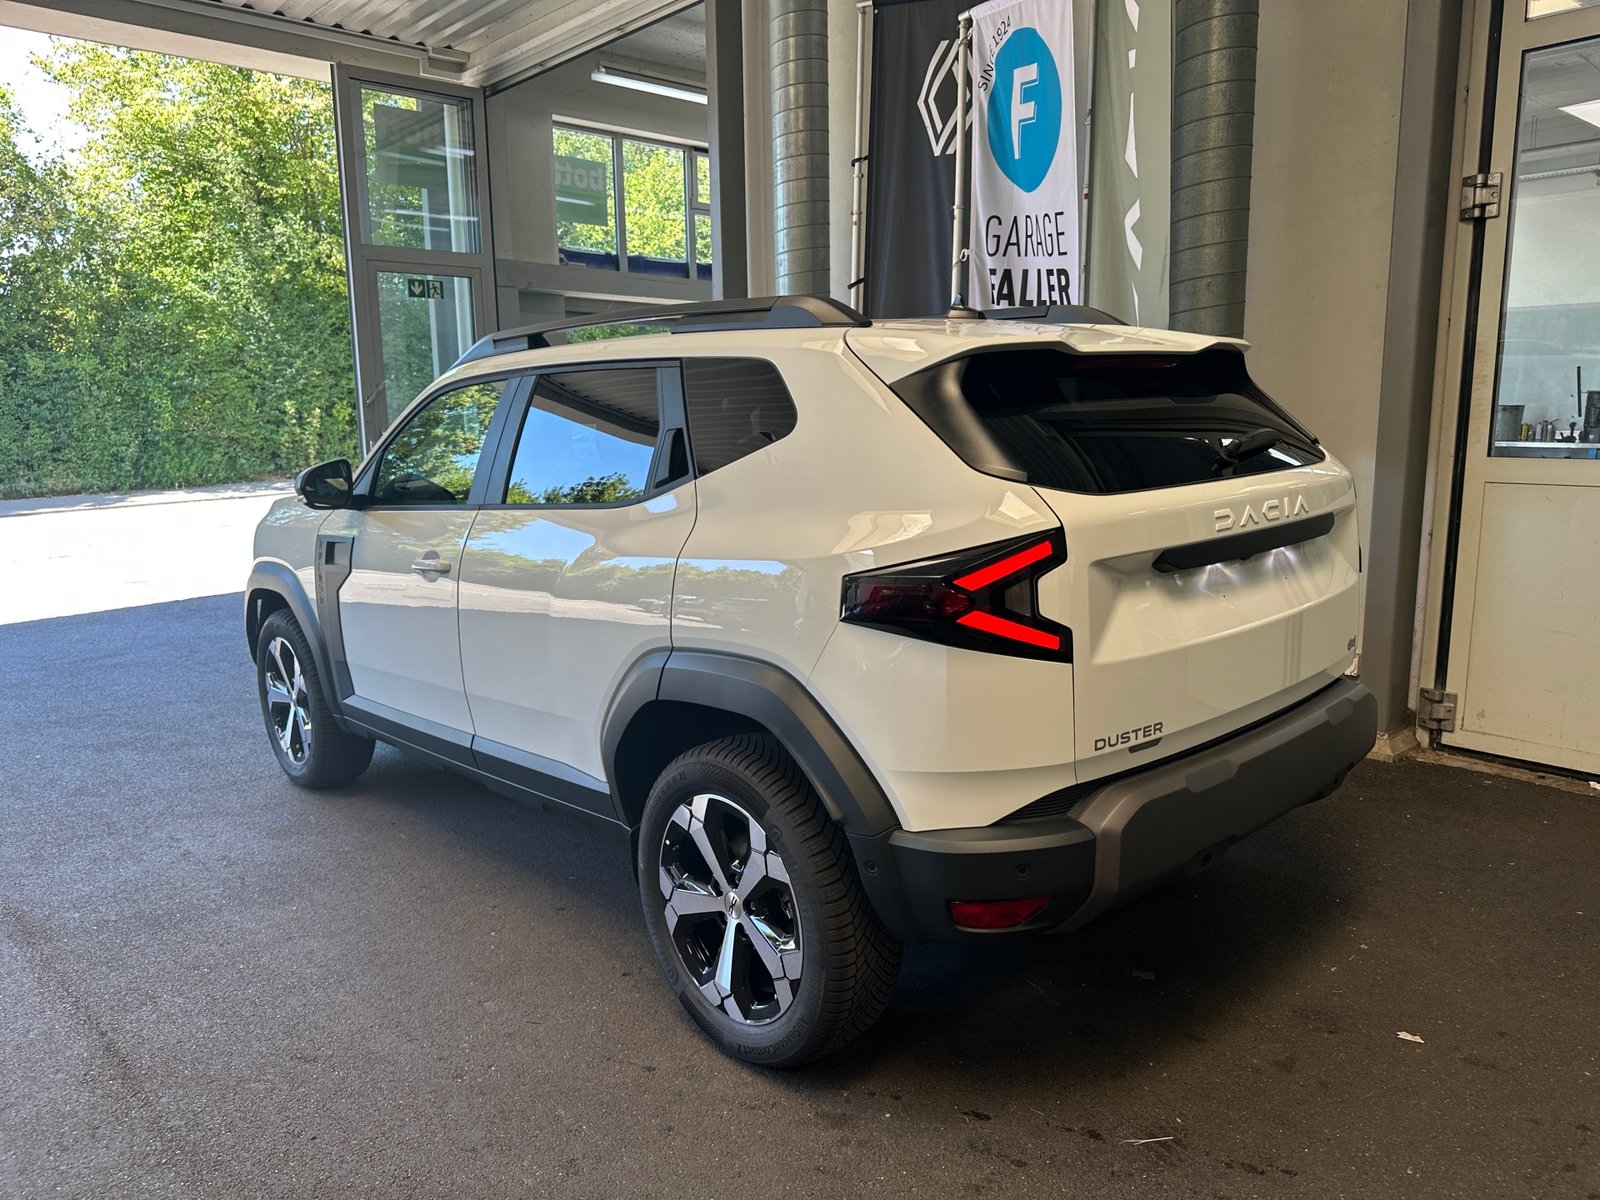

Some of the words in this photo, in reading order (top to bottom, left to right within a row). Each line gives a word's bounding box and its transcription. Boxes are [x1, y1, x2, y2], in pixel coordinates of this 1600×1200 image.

[992, 15, 1012, 48] 1924
[1011, 62, 1039, 160] F
[985, 211, 1067, 257] GARAGE
[989, 268, 1071, 307] FALLER
[1214, 494, 1309, 532] DACIA
[1094, 721, 1163, 751] DUSTER
